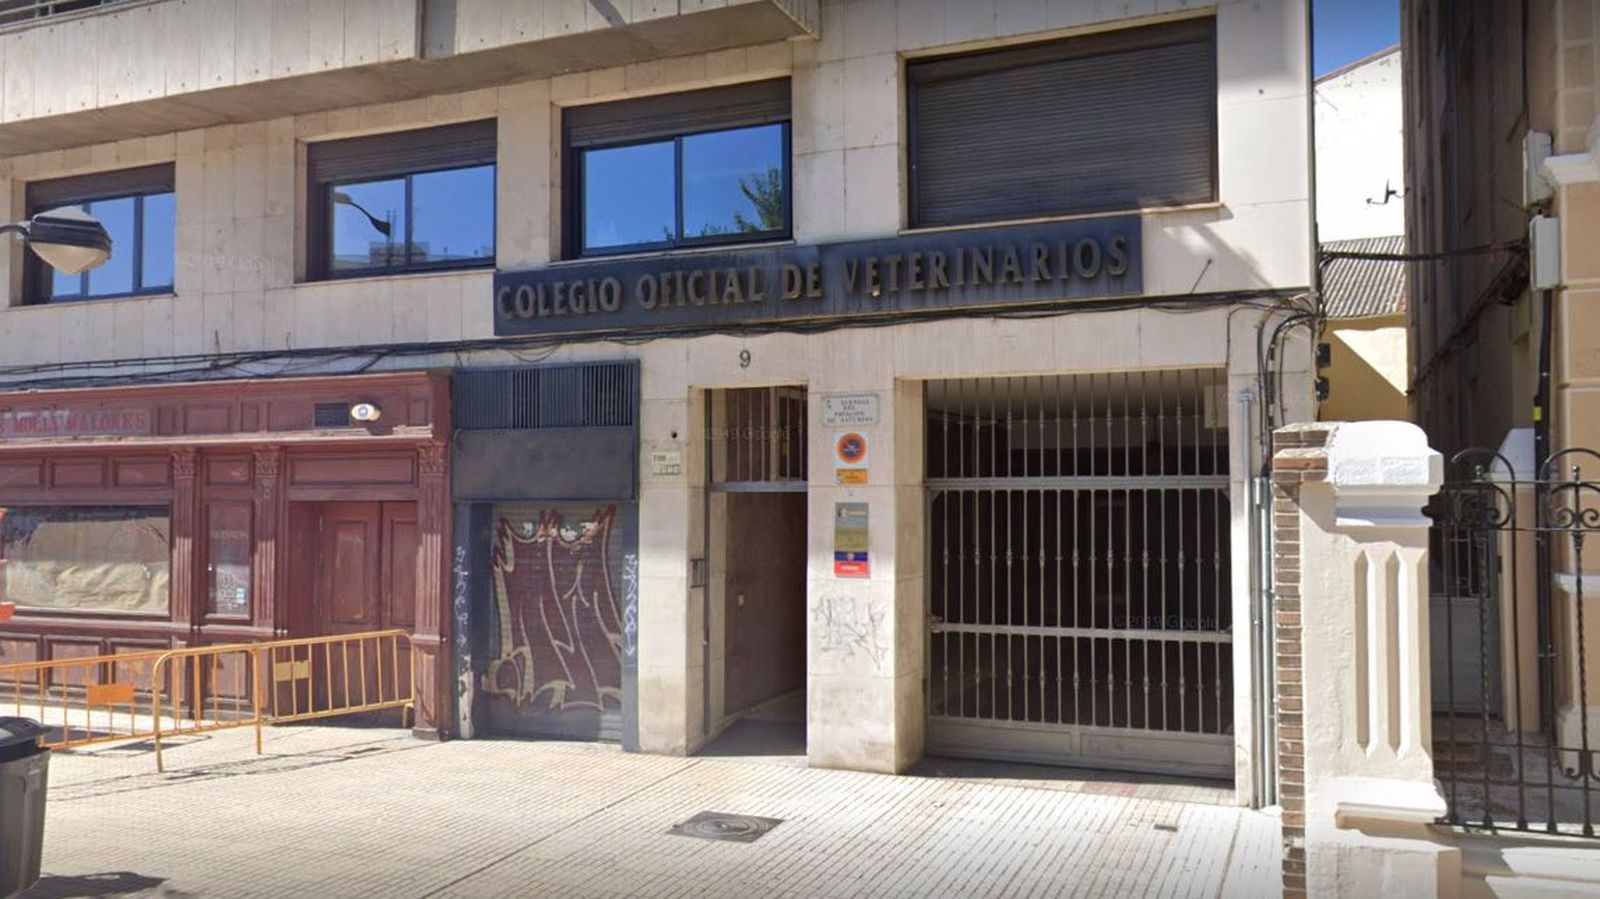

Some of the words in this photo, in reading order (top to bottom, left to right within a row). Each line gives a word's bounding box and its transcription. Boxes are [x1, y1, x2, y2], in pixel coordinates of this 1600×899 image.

[497, 276, 622, 320] COLEGIO
[635, 266, 767, 310] OFICIAL
[781, 261, 822, 301] DE
[840, 234, 1128, 294] VETERINARIOS
[739, 349, 751, 368] 9
